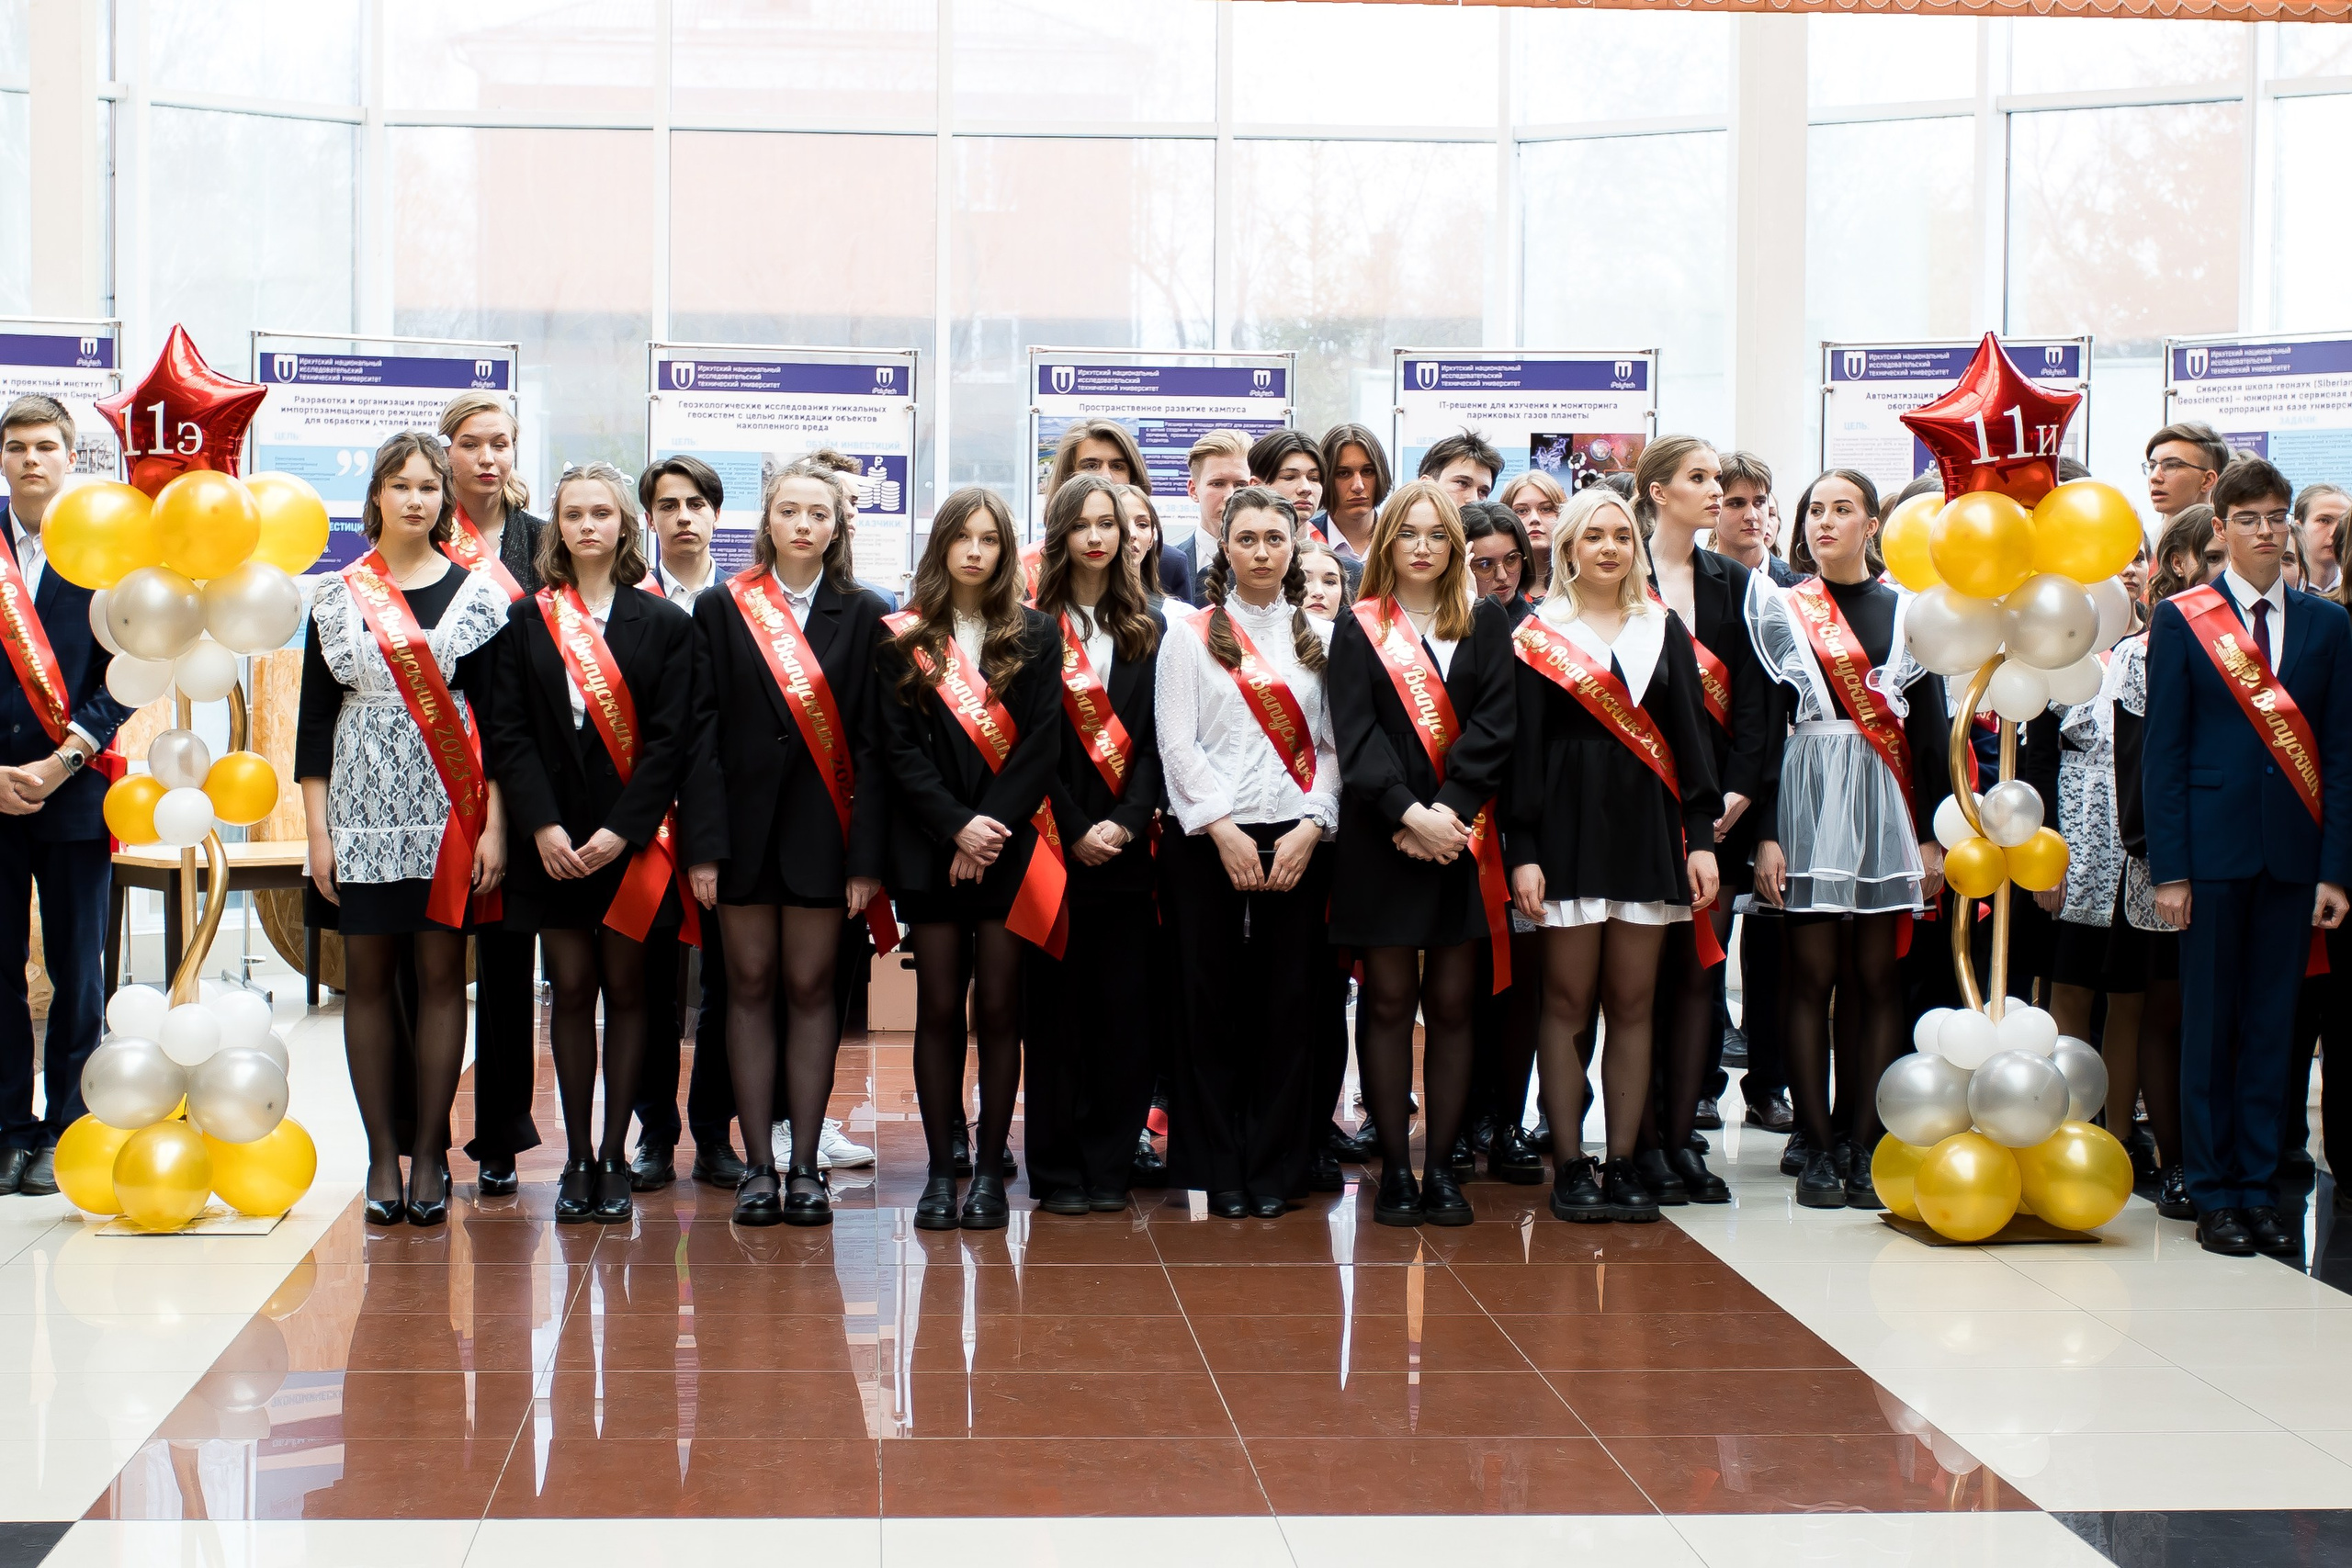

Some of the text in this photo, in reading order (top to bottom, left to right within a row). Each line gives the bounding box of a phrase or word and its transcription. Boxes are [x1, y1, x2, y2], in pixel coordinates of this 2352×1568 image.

[1869, 352, 1950, 362] Иркутский национальный
[2211, 347, 2291, 358] Иркутский национальный
[299, 357, 382, 367] Иркутский национальный
[1869, 361, 1930, 369] исследовательский
[2211, 356, 2272, 367] исследовательский
[299, 366, 363, 375] исследовательский
[697, 365, 781, 374] Иркутский национальный
[1078, 368, 1112, 378] Иркутский
[1442, 364, 1474, 373] Иркутский
[1869, 367, 1950, 378] технический университет
[2211, 365, 2291, 375] технический университет
[11, 377, 61, 387] проектный
[299, 374, 382, 384] технический университет
[697, 373, 762, 381] исследовательский
[1078, 377, 1141, 385] исследовательский
[697, 380, 781, 389] технический университет
[1078, 384, 1160, 393] технический университет
[2196, 381, 2311, 394] Сибирская школа геонаук
[1866, 392, 1934, 400] Автоматизация
[2244, 393, 2289, 402] юниорная
[2299, 391, 2346, 401] сервисная
[294, 395, 347, 405] Разработка
[358, 399, 415, 408] организация
[678, 400, 762, 411] Геоэкологические
[764, 403, 829, 412] исследования
[1439, 401, 1487, 411] IT-решение
[1509, 402, 1550, 411] изучения
[1560, 402, 1619, 411] мониторинга
[281, 407, 386, 417] импортозамещающего
[388, 410, 433, 418] режущего
[1079, 403, 1162, 413] Пространственное
[1165, 405, 1206, 414] развитие
[2219, 406, 2270, 415] корпорация
[304, 418, 322, 426] для
[324, 417, 370, 426] обработки
[687, 412, 735, 420] геосистем
[745, 413, 775, 422] целью
[777, 413, 832, 423] ликвидации
[1466, 412, 1521, 421] парниковых
[1551, 412, 1589, 420] планеты
[736, 423, 829, 433] накопленного вреда
[1817, 620, 1882, 732] Выпускник
[376, 604, 472, 782] Выпускник 2023
[568, 633, 634, 751] Выпускник
[771, 632, 837, 752] Выпускник
[1545, 645, 1643, 738] Выпускник
[2250, 687, 2319, 797] Выпускник
